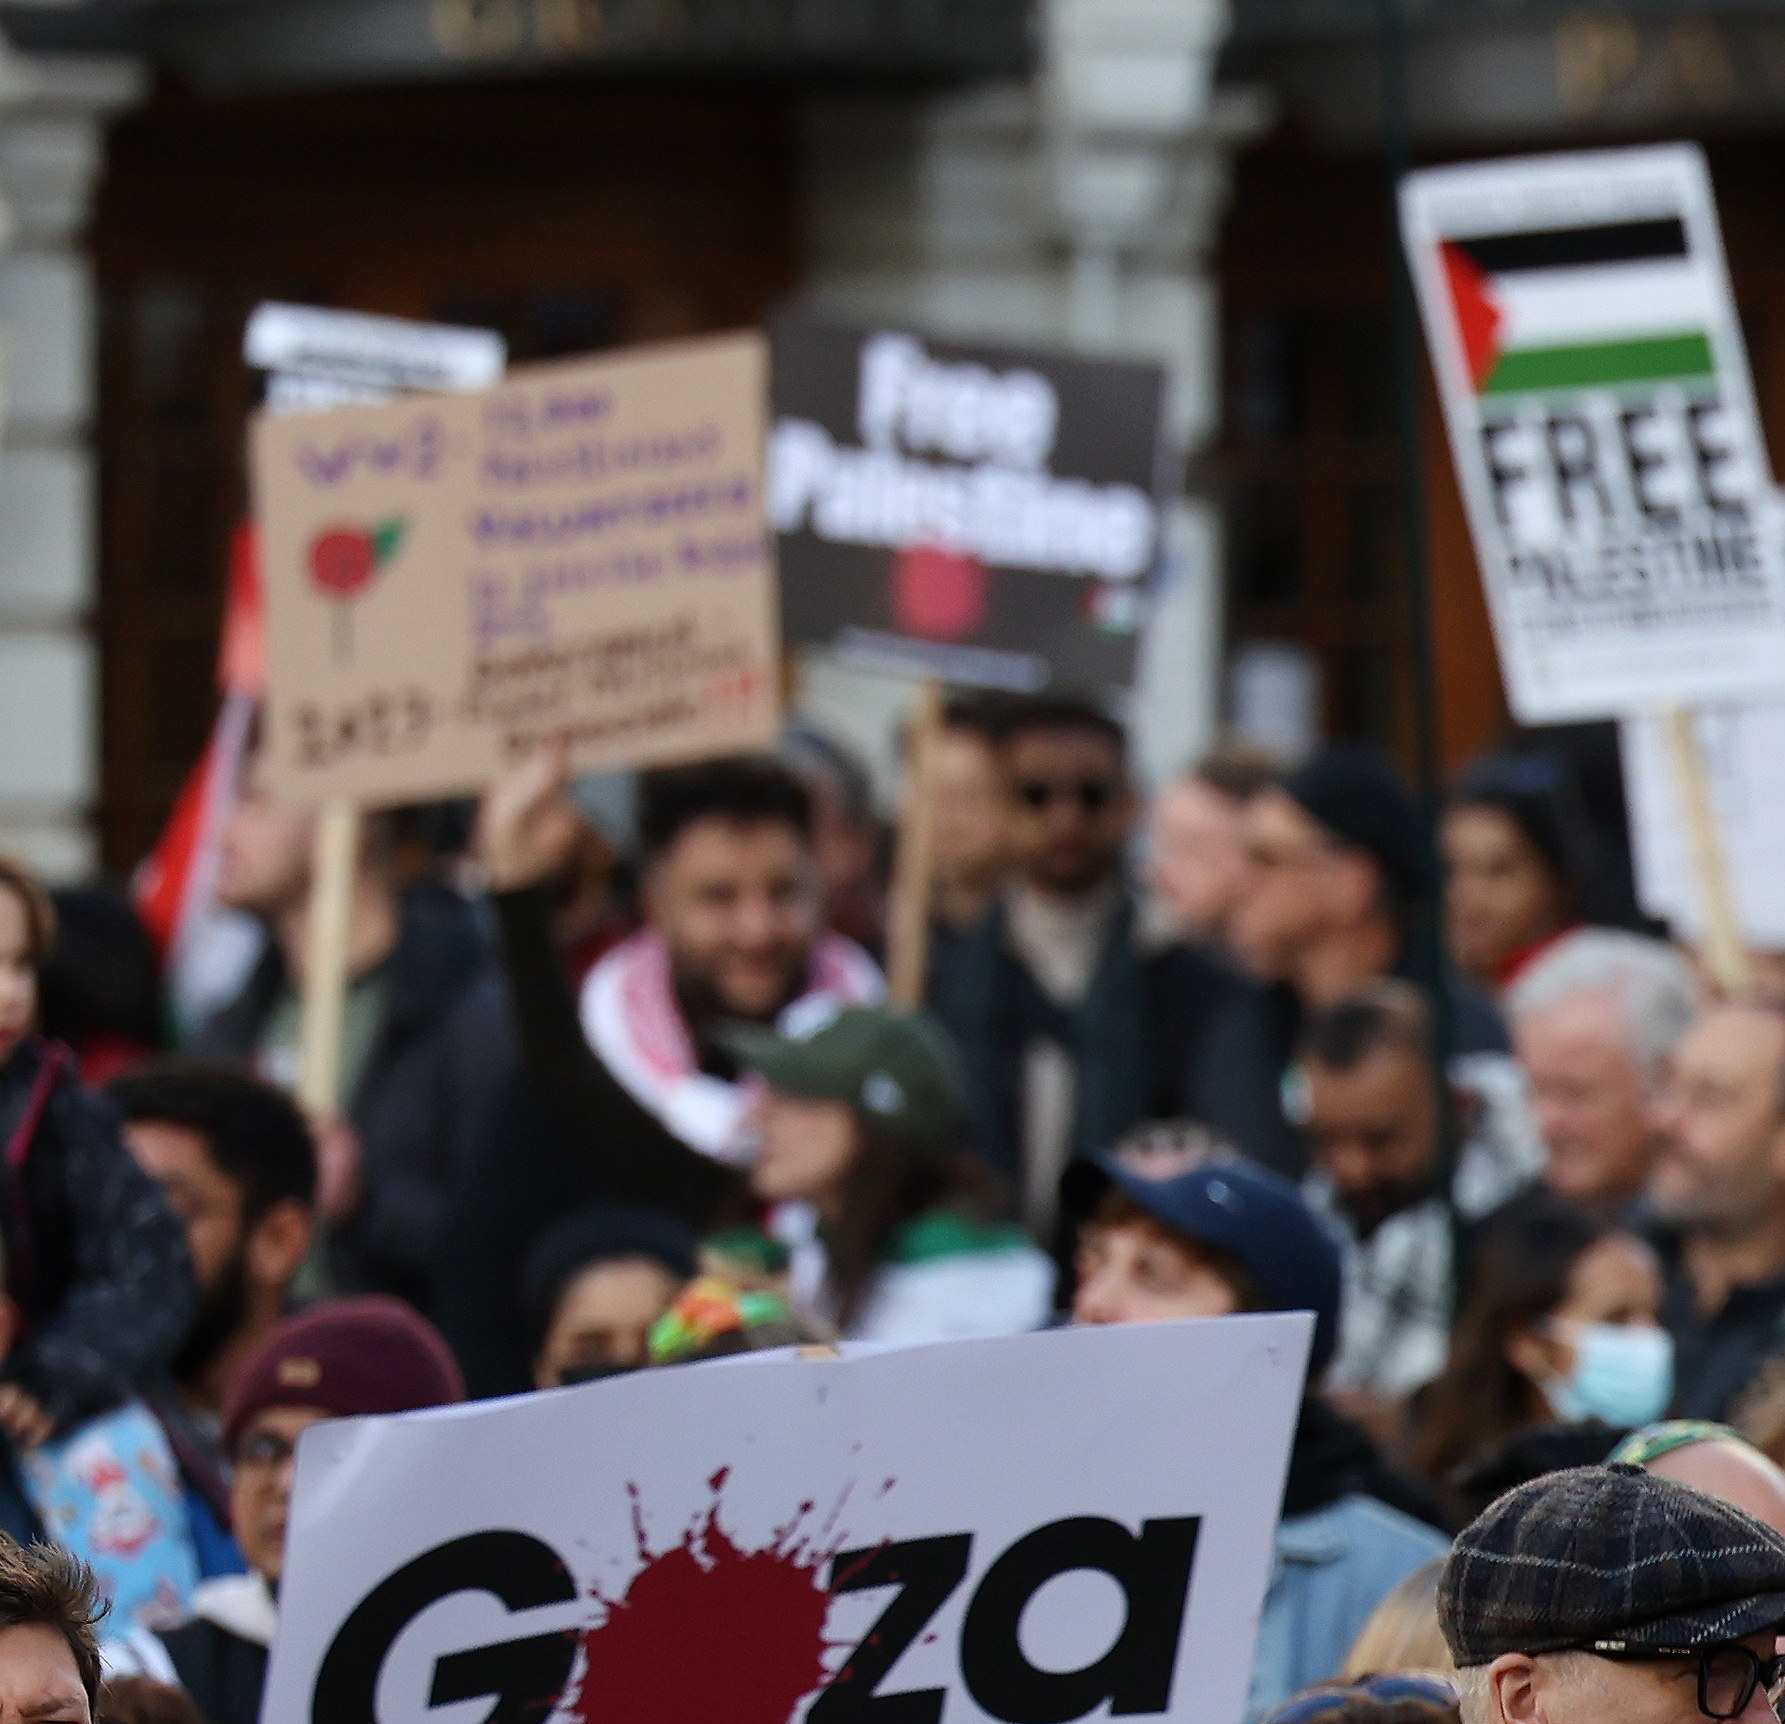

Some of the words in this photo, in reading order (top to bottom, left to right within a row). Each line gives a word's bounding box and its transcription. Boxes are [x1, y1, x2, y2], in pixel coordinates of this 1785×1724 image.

[859, 332, 1058, 464] Free
[767, 417, 1155, 578] Palestine
[1481, 400, 1750, 527] FREE
[1507, 533, 1766, 599] PALESTINE
